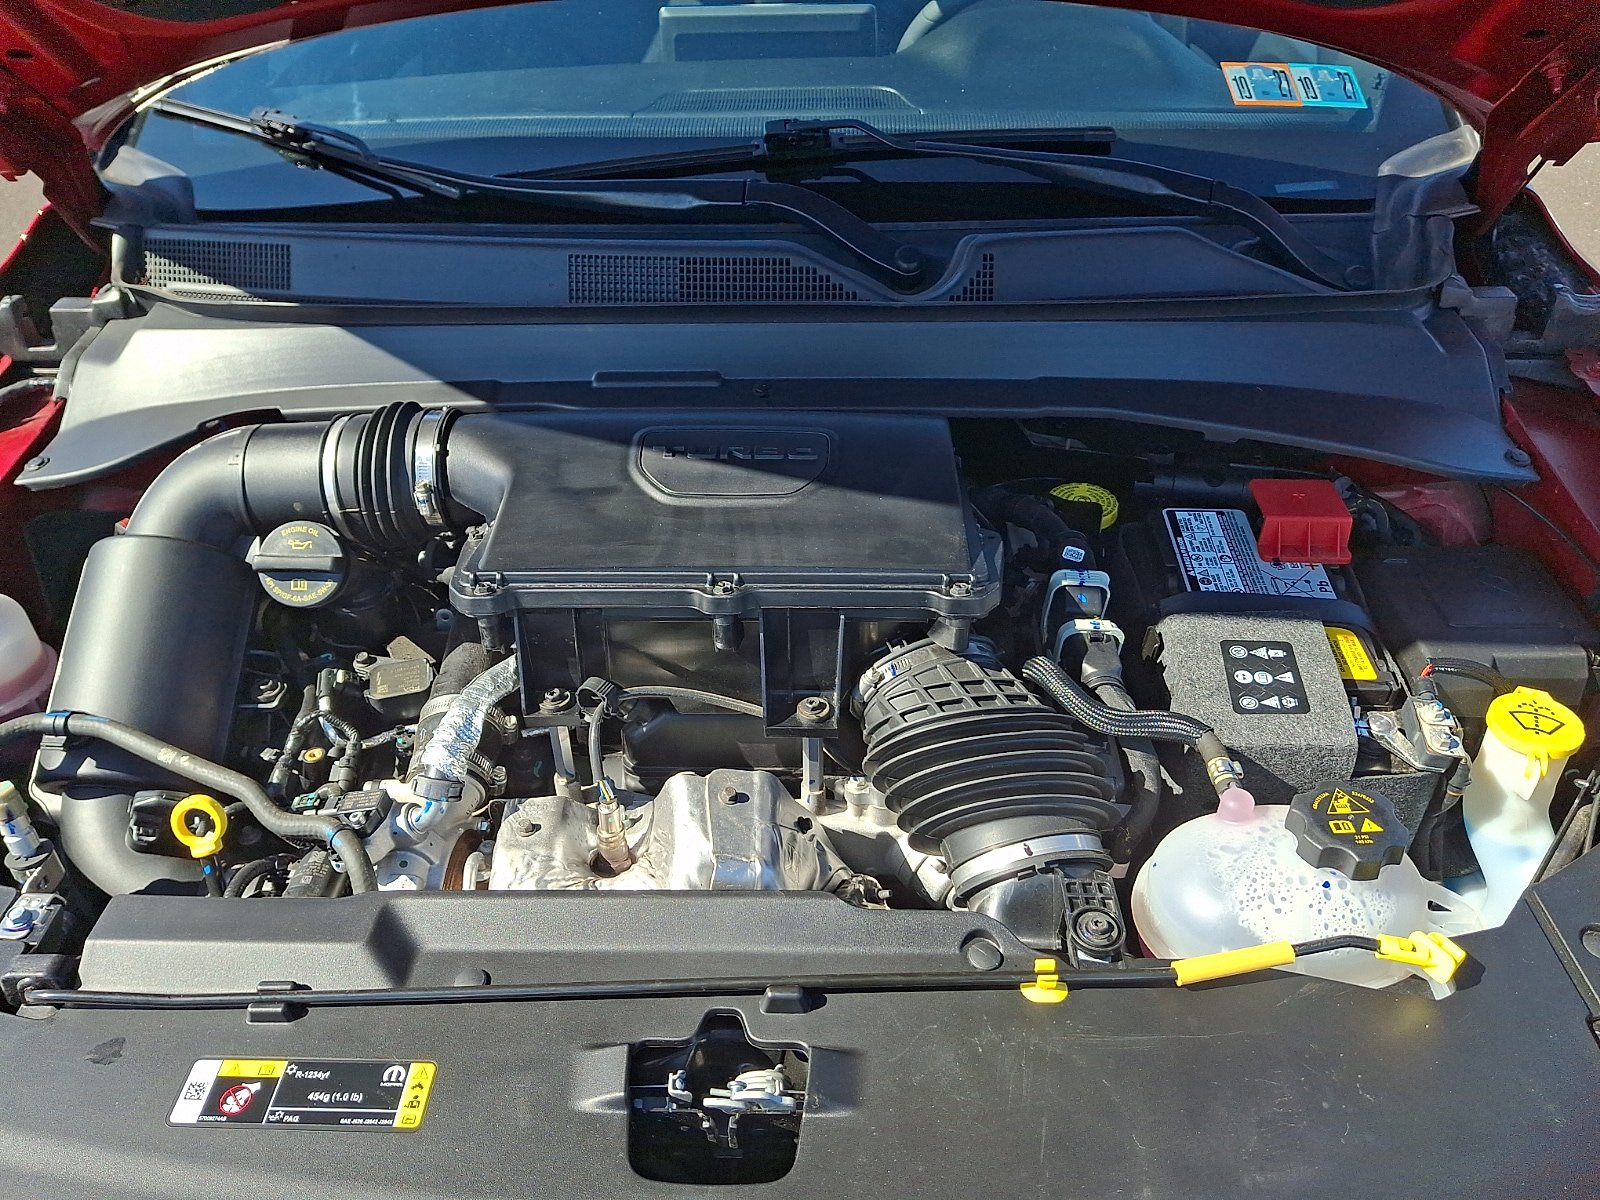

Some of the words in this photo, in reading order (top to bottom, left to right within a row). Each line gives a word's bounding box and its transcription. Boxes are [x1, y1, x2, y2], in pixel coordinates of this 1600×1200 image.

[1273, 70, 1293, 99] 27
[1337, 71, 1357, 100] 27
[652, 446, 818, 460] TURBO
[281, 526, 307, 538] ENGINE
[308, 526, 319, 538] OIL
[1316, 580, 1333, 594] Pb
[294, 1070, 331, 1080] R-1234yf
[307, 1091, 331, 1103] 454g
[331, 1091, 349, 1103] (1.0
[349, 1092, 364, 1103] lb)
[282, 1114, 300, 1123] PAG
